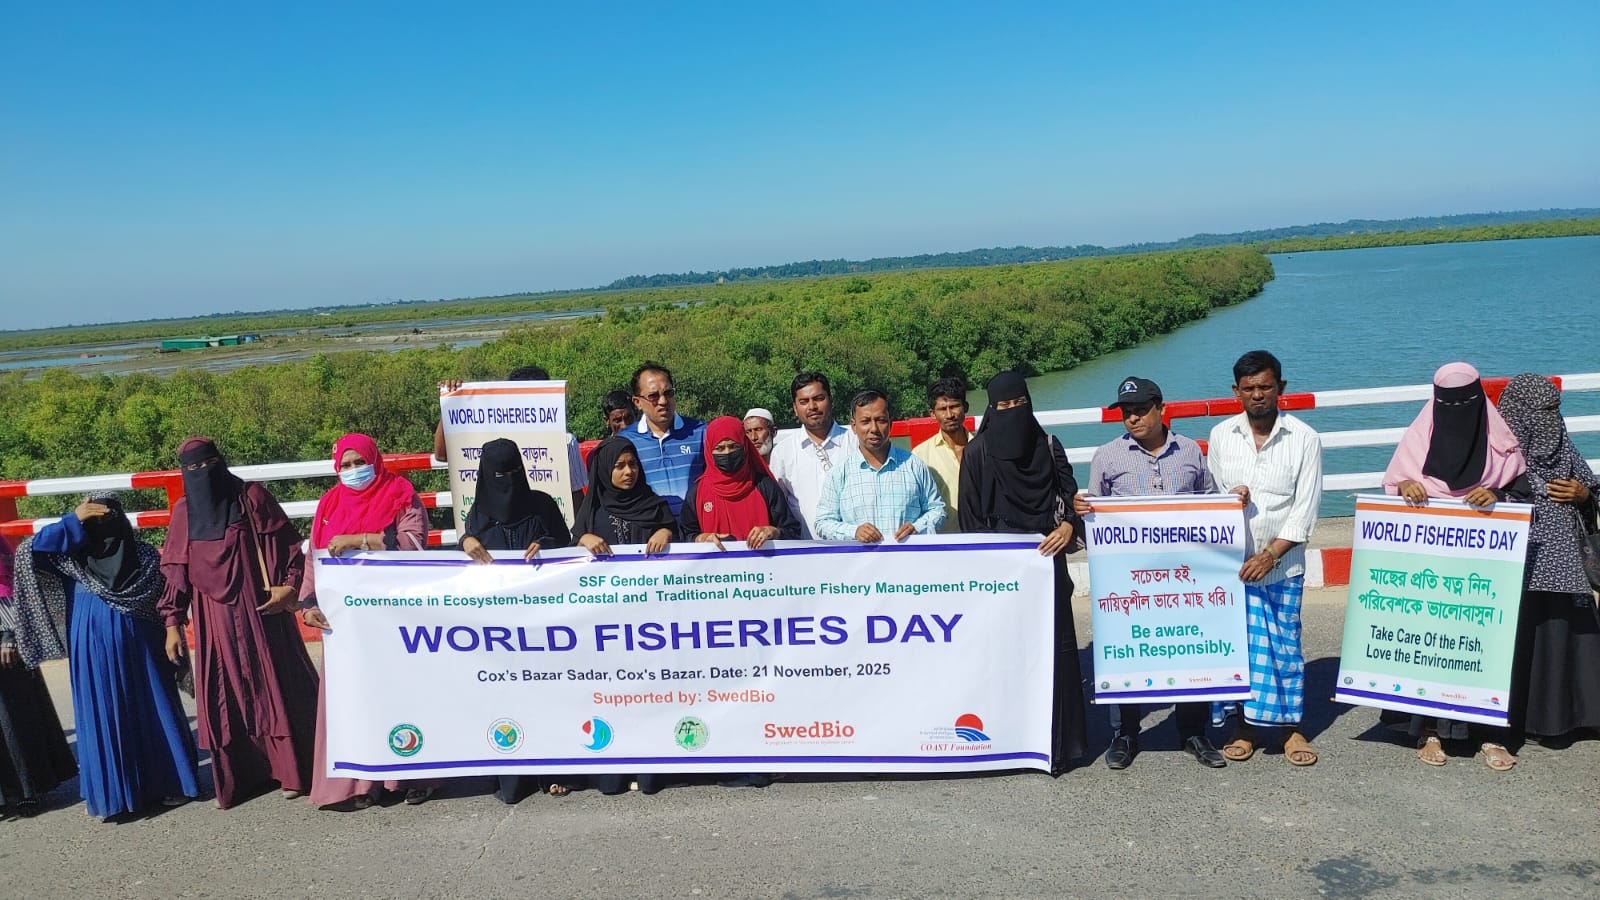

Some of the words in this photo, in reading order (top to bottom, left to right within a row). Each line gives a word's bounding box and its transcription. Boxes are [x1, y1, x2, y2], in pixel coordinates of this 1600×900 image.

[448, 408, 485, 424] WORLD
[488, 408, 536, 424] FISHERIES
[540, 408, 558, 423] DAY
[1093, 526, 1138, 545] WORLD
[1142, 526, 1206, 544] FISHERIES
[1210, 526, 1235, 544] DAY
[1362, 521, 1412, 542] WORLD
[1415, 524, 1485, 548] FISHERIES
[1489, 530, 1518, 550] DAY
[579, 576, 605, 588] SSF
[610, 574, 659, 587] Gender
[663, 572, 764, 586] Mainstreaming
[1130, 568, 1170, 585] সচেতন
[1370, 568, 1408, 588] মাছের
[1410, 568, 1439, 590] প্রতি
[1442, 576, 1464, 596] যত্ন
[344, 594, 423, 607] Governance
[426, 594, 440, 606] in
[443, 592, 564, 608] Ecosystem-based
[568, 590, 618, 604] Coastal
[622, 590, 648, 603] and
[656, 588, 728, 602] Traditional
[732, 584, 816, 600] Aquaculture
[820, 582, 870, 596] Fishery
[875, 580, 965, 595] Management
[969, 580, 1020, 594] Project
[1153, 593, 1179, 608] ভাবে
[1183, 592, 1204, 608] মাছ
[1208, 586, 1226, 606] ধরি
[1358, 589, 1423, 615] পরিবেশকে
[1427, 600, 1495, 626] ভালোবাসুন
[398, 626, 578, 654] WORLD
[594, 616, 848, 652] FISHERIES
[866, 614, 964, 644] DAY
[1132, 624, 1150, 638] Be
[1155, 624, 1204, 638] aware,
[1370, 625, 1394, 642] Take
[1396, 628, 1421, 646] Care
[1424, 632, 1438, 646] Of
[1439, 634, 1456, 650] the
[1458, 636, 1484, 654] Fish,
[1104, 644, 1134, 660] Fish
[1140, 640, 1235, 659] Responsibly.
[1366, 644, 1391, 660] Love
[1394, 648, 1411, 663] the
[1414, 651, 1483, 672] Environment.
[522, 669, 563, 681] Bazar
[567, 668, 612, 682] Sadar,
[660, 668, 706, 681] Bazar.
[710, 667, 748, 679] Date:
[752, 666, 768, 677] 21
[774, 664, 852, 678] November,
[856, 663, 891, 676] 2025
[593, 690, 673, 708] Supported
[678, 690, 702, 706] by:
[707, 690, 775, 703] SwedBio
[764, 720, 854, 738] SwedBio
[950, 743, 992, 751] Foundation
